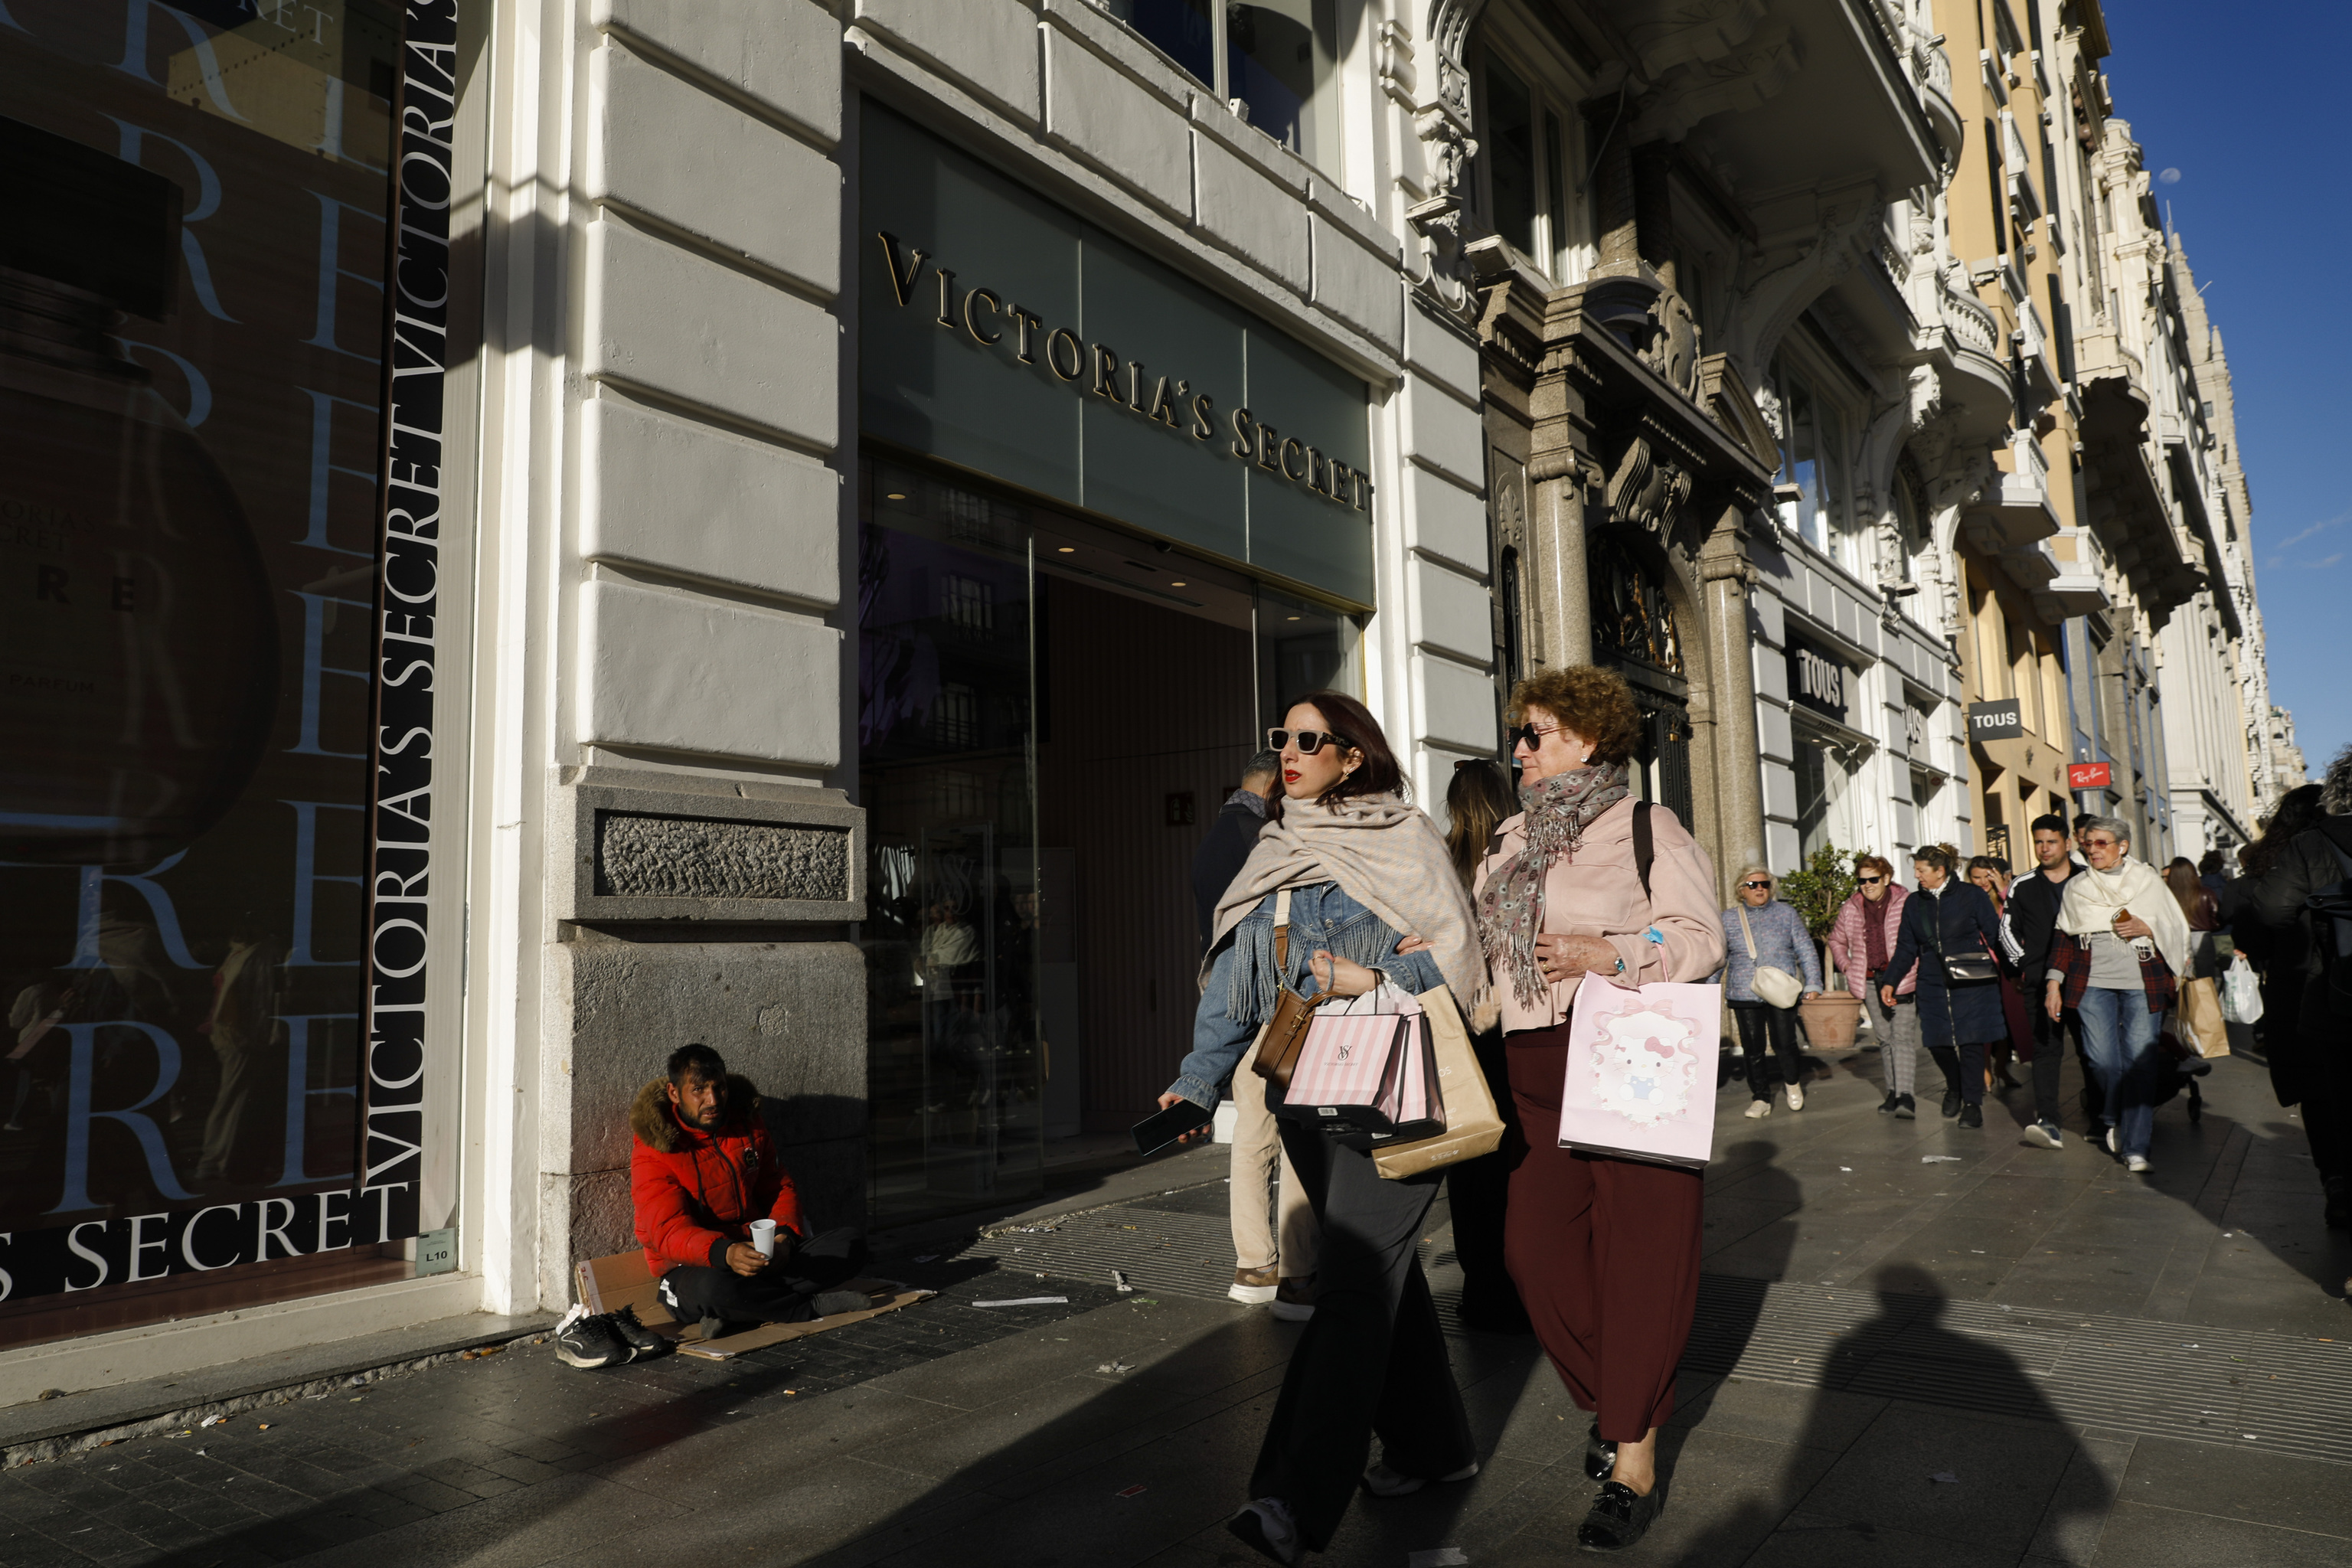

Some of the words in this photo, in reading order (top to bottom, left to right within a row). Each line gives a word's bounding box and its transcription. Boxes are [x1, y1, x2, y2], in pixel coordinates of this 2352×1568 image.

[878, 231, 1214, 439] VICTORIA'S
[1231, 408, 1369, 511] SECRET
[381, 403, 443, 693] SECRET
[1796, 648, 1841, 707] TOUS
[1973, 712, 2017, 728] TOUS
[366, 726, 434, 1186] VICTORIA'S
[64, 1181, 408, 1293] SECRET
[426, 1250, 448, 1262] L10
